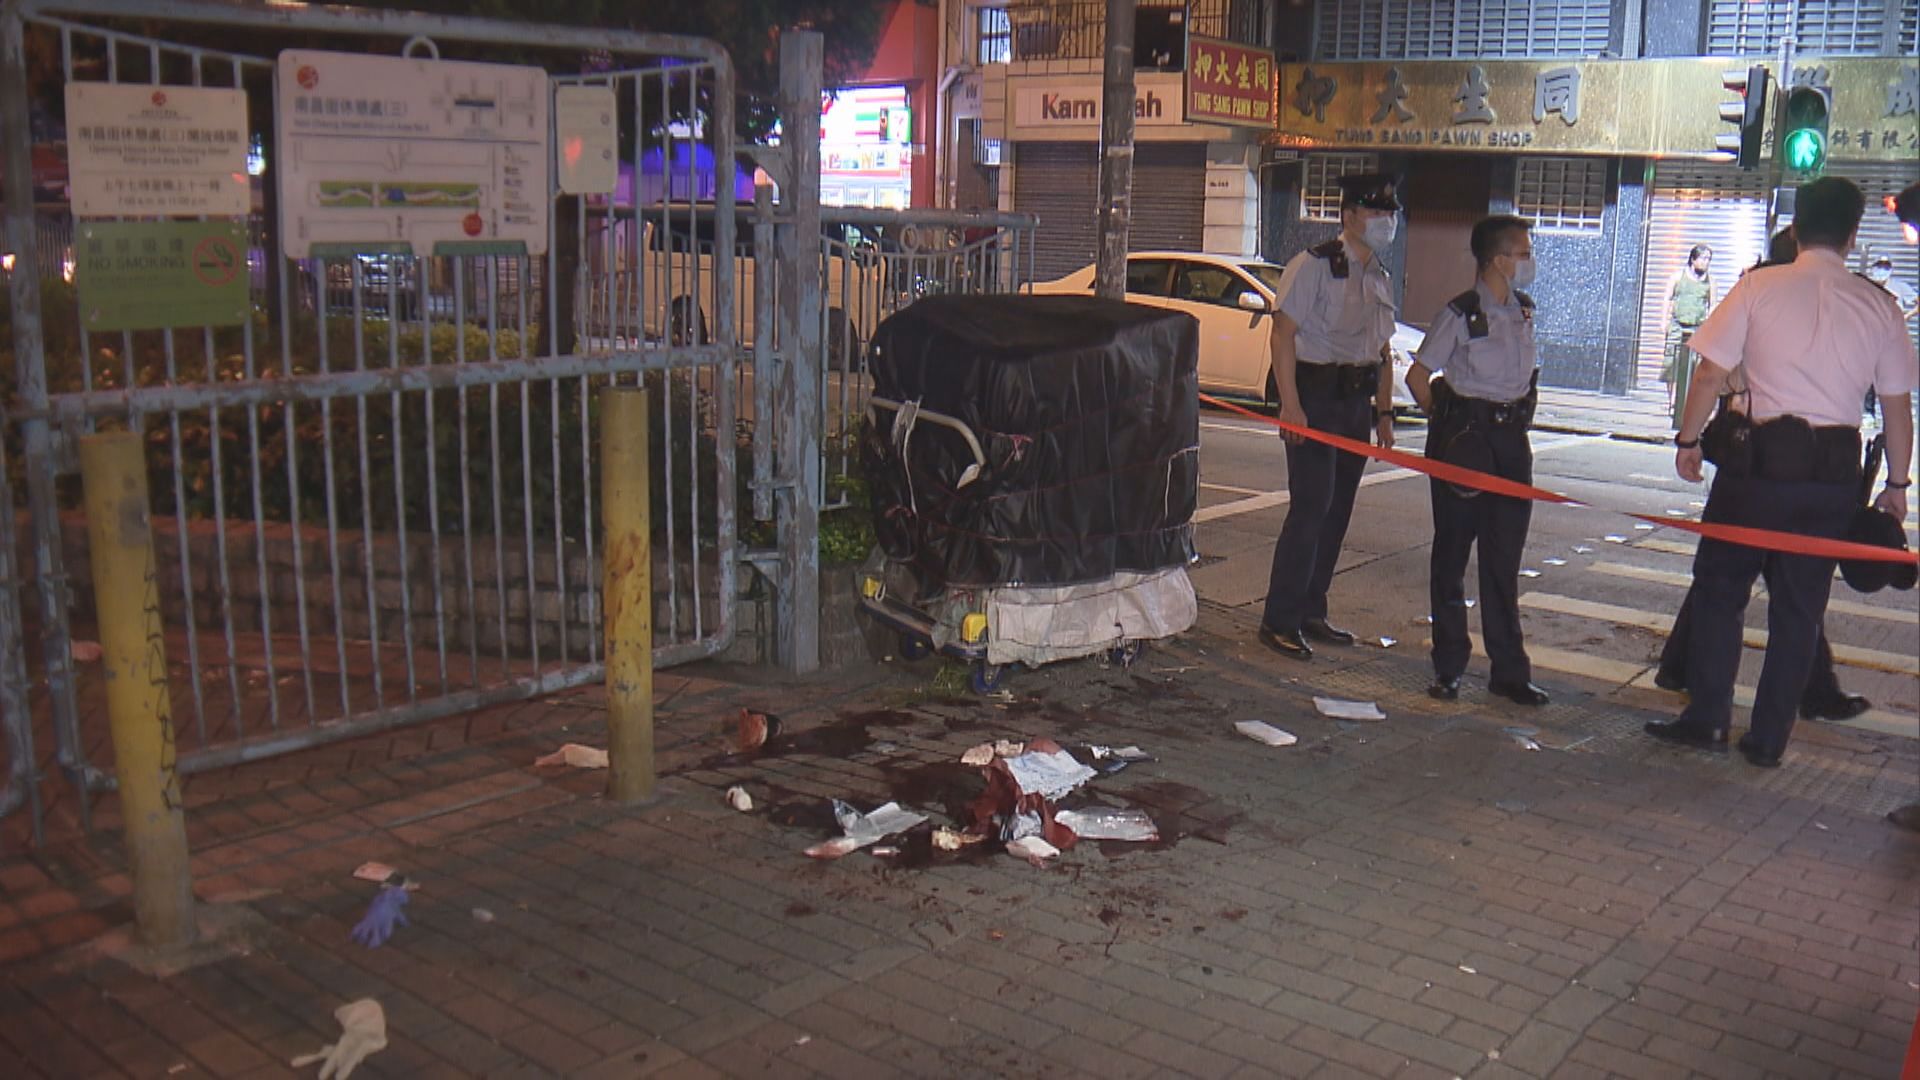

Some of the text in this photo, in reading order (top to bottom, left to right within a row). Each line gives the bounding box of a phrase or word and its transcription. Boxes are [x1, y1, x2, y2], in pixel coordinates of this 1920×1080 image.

[1042, 90, 1162, 119] Kam ah
[1193, 91, 1269, 119] TUNG SANG PAWN SHOP
[1336, 129, 1533, 147] TUNG SANG PAWN SHOP
[88, 256, 185, 271] NO SMOKING
